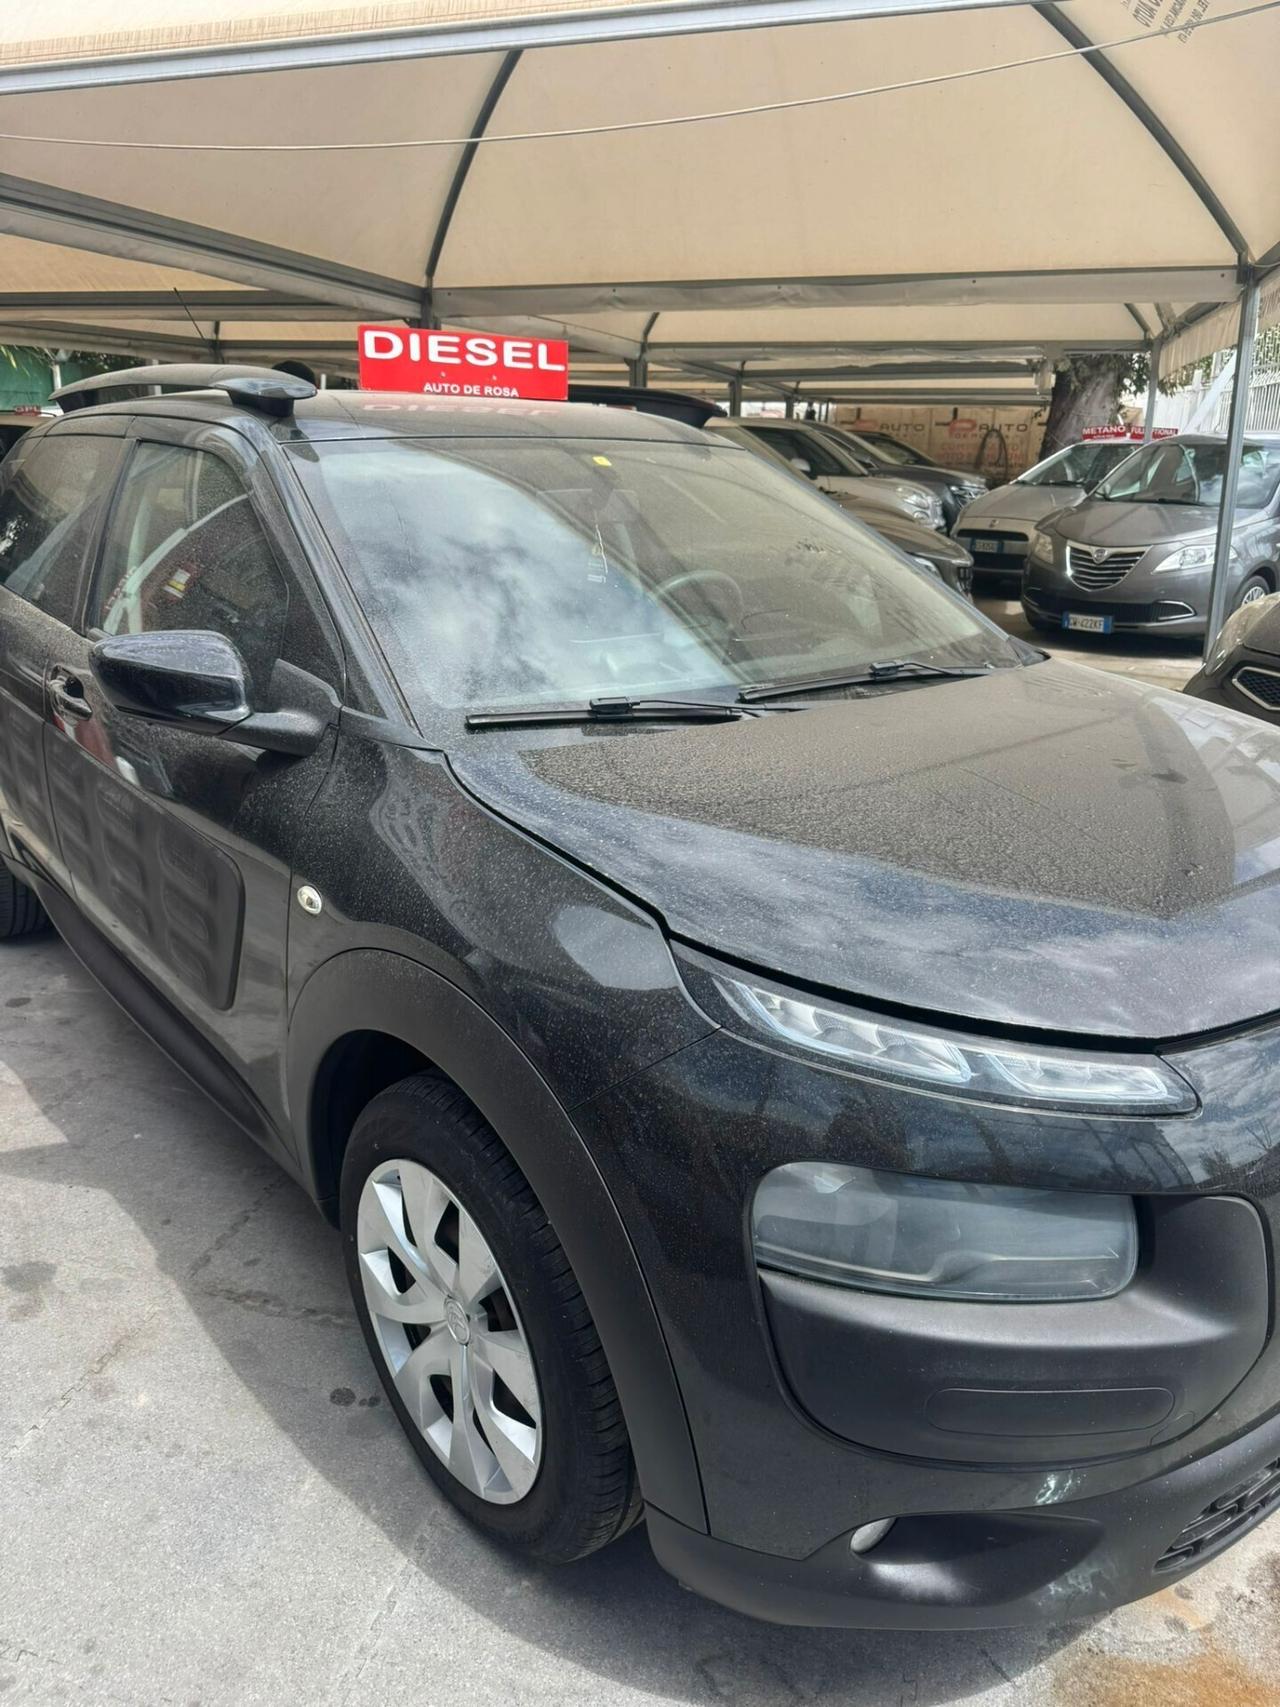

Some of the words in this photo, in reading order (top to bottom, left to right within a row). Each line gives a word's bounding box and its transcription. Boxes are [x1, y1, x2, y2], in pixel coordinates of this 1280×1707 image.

[363, 330, 566, 372] DIESEL
[423, 382, 461, 395] AUTO
[463, 384, 481, 396] DE
[484, 385, 519, 398] ROSA
[978, 423, 1028, 433] AUTO
[1082, 425, 1126, 435] METANO
